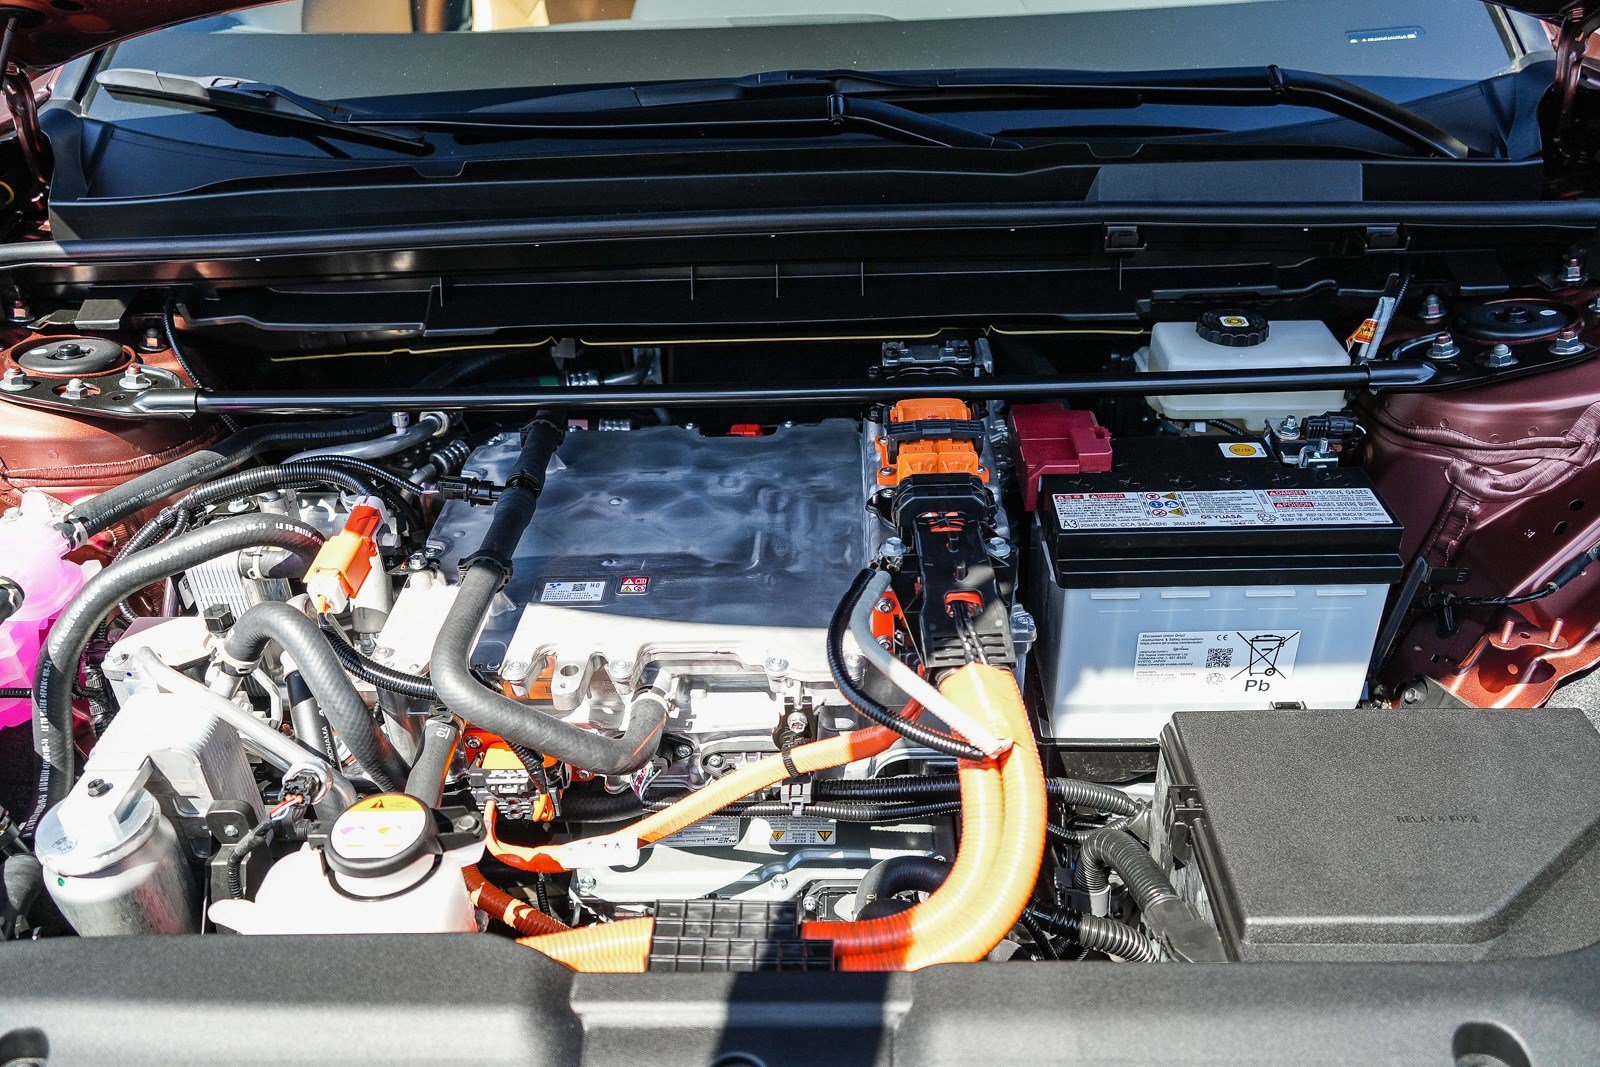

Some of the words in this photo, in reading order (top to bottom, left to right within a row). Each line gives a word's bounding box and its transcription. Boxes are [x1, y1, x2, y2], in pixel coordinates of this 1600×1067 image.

[1063, 520, 1078, 528] A3
[1244, 680, 1270, 692] Pb
[322, 726, 335, 767] YOKOHAMA
